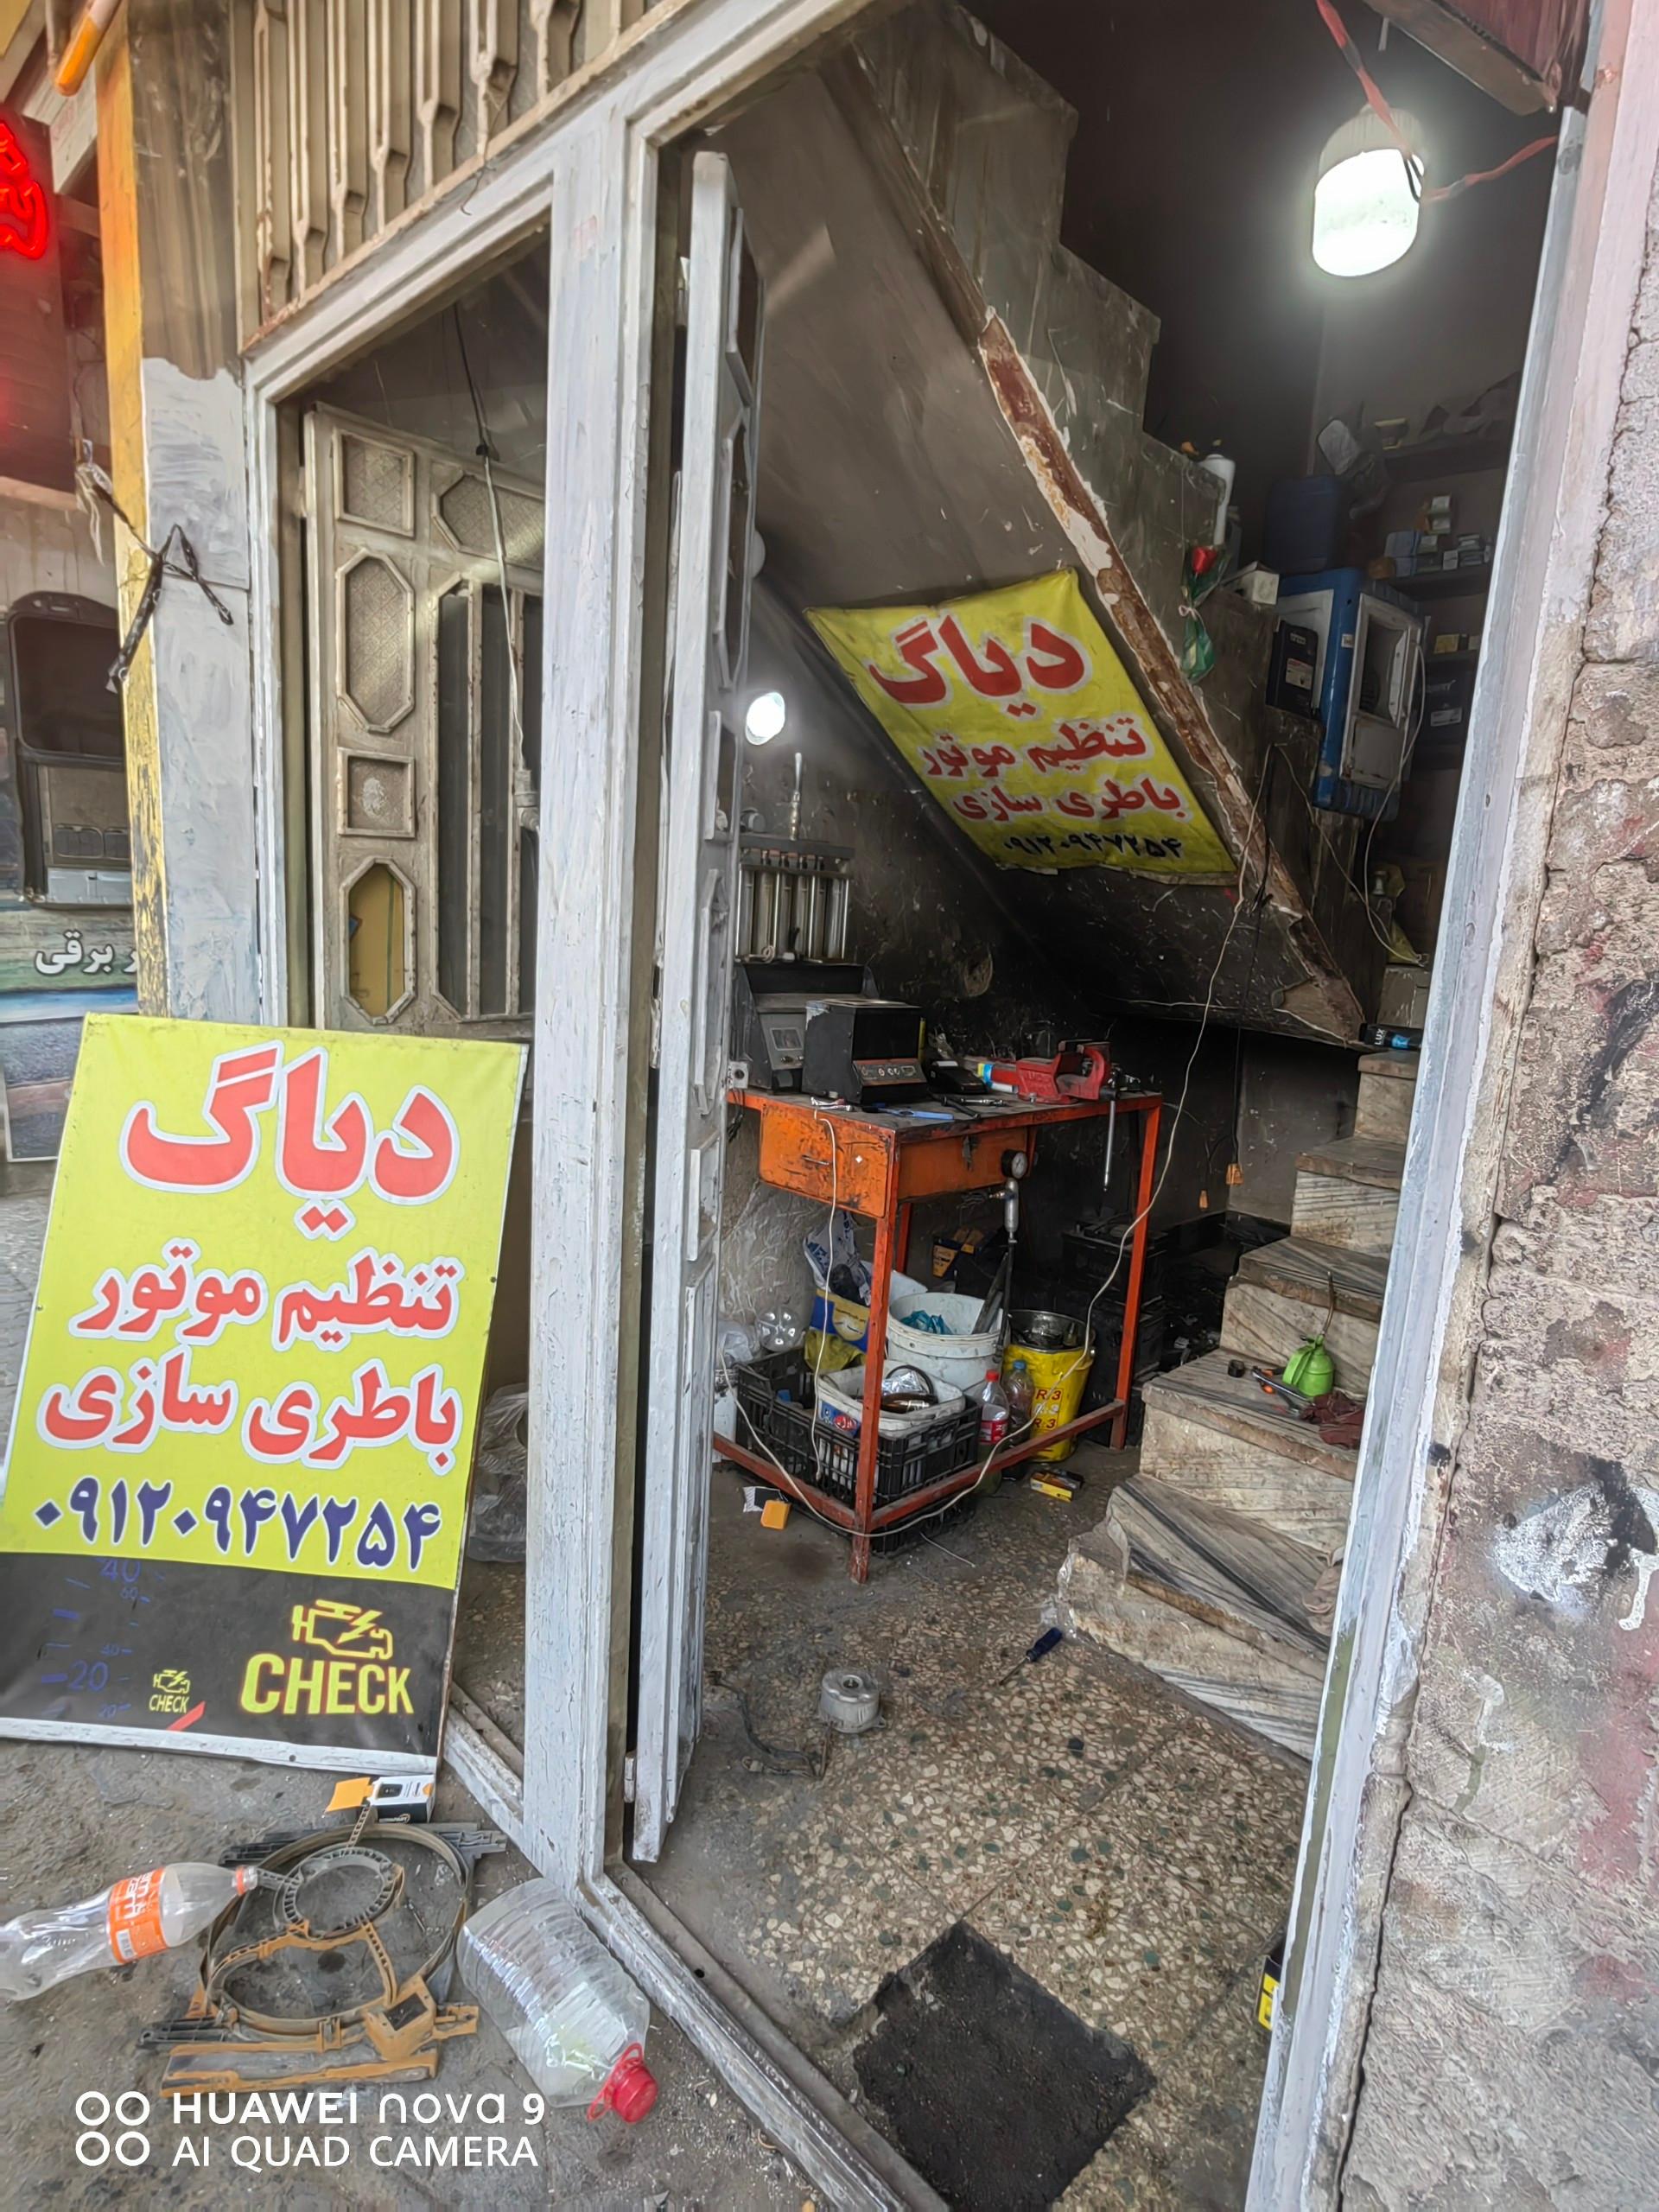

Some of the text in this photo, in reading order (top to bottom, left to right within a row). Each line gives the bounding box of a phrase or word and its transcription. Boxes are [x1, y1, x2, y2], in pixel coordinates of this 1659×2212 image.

[868, 614, 1087, 718] دیاگ
[921, 716, 1148, 778] تنظیم موتور
[953, 777, 1185, 823] باطری سازی
[35, 930, 114, 974] برقی
[1374, 1028, 1384, 1046] LUX
[124, 1046, 455, 1232] دیاگ
[76, 1245, 458, 1344] تنظیم موتور
[44, 1353, 458, 1467] باطری سازی
[99, 1559, 141, 1582] 40
[67, 1660, 109, 1692] 20
[239, 1652, 414, 1716] CHECK
[149, 1694, 190, 1713] CHECK
